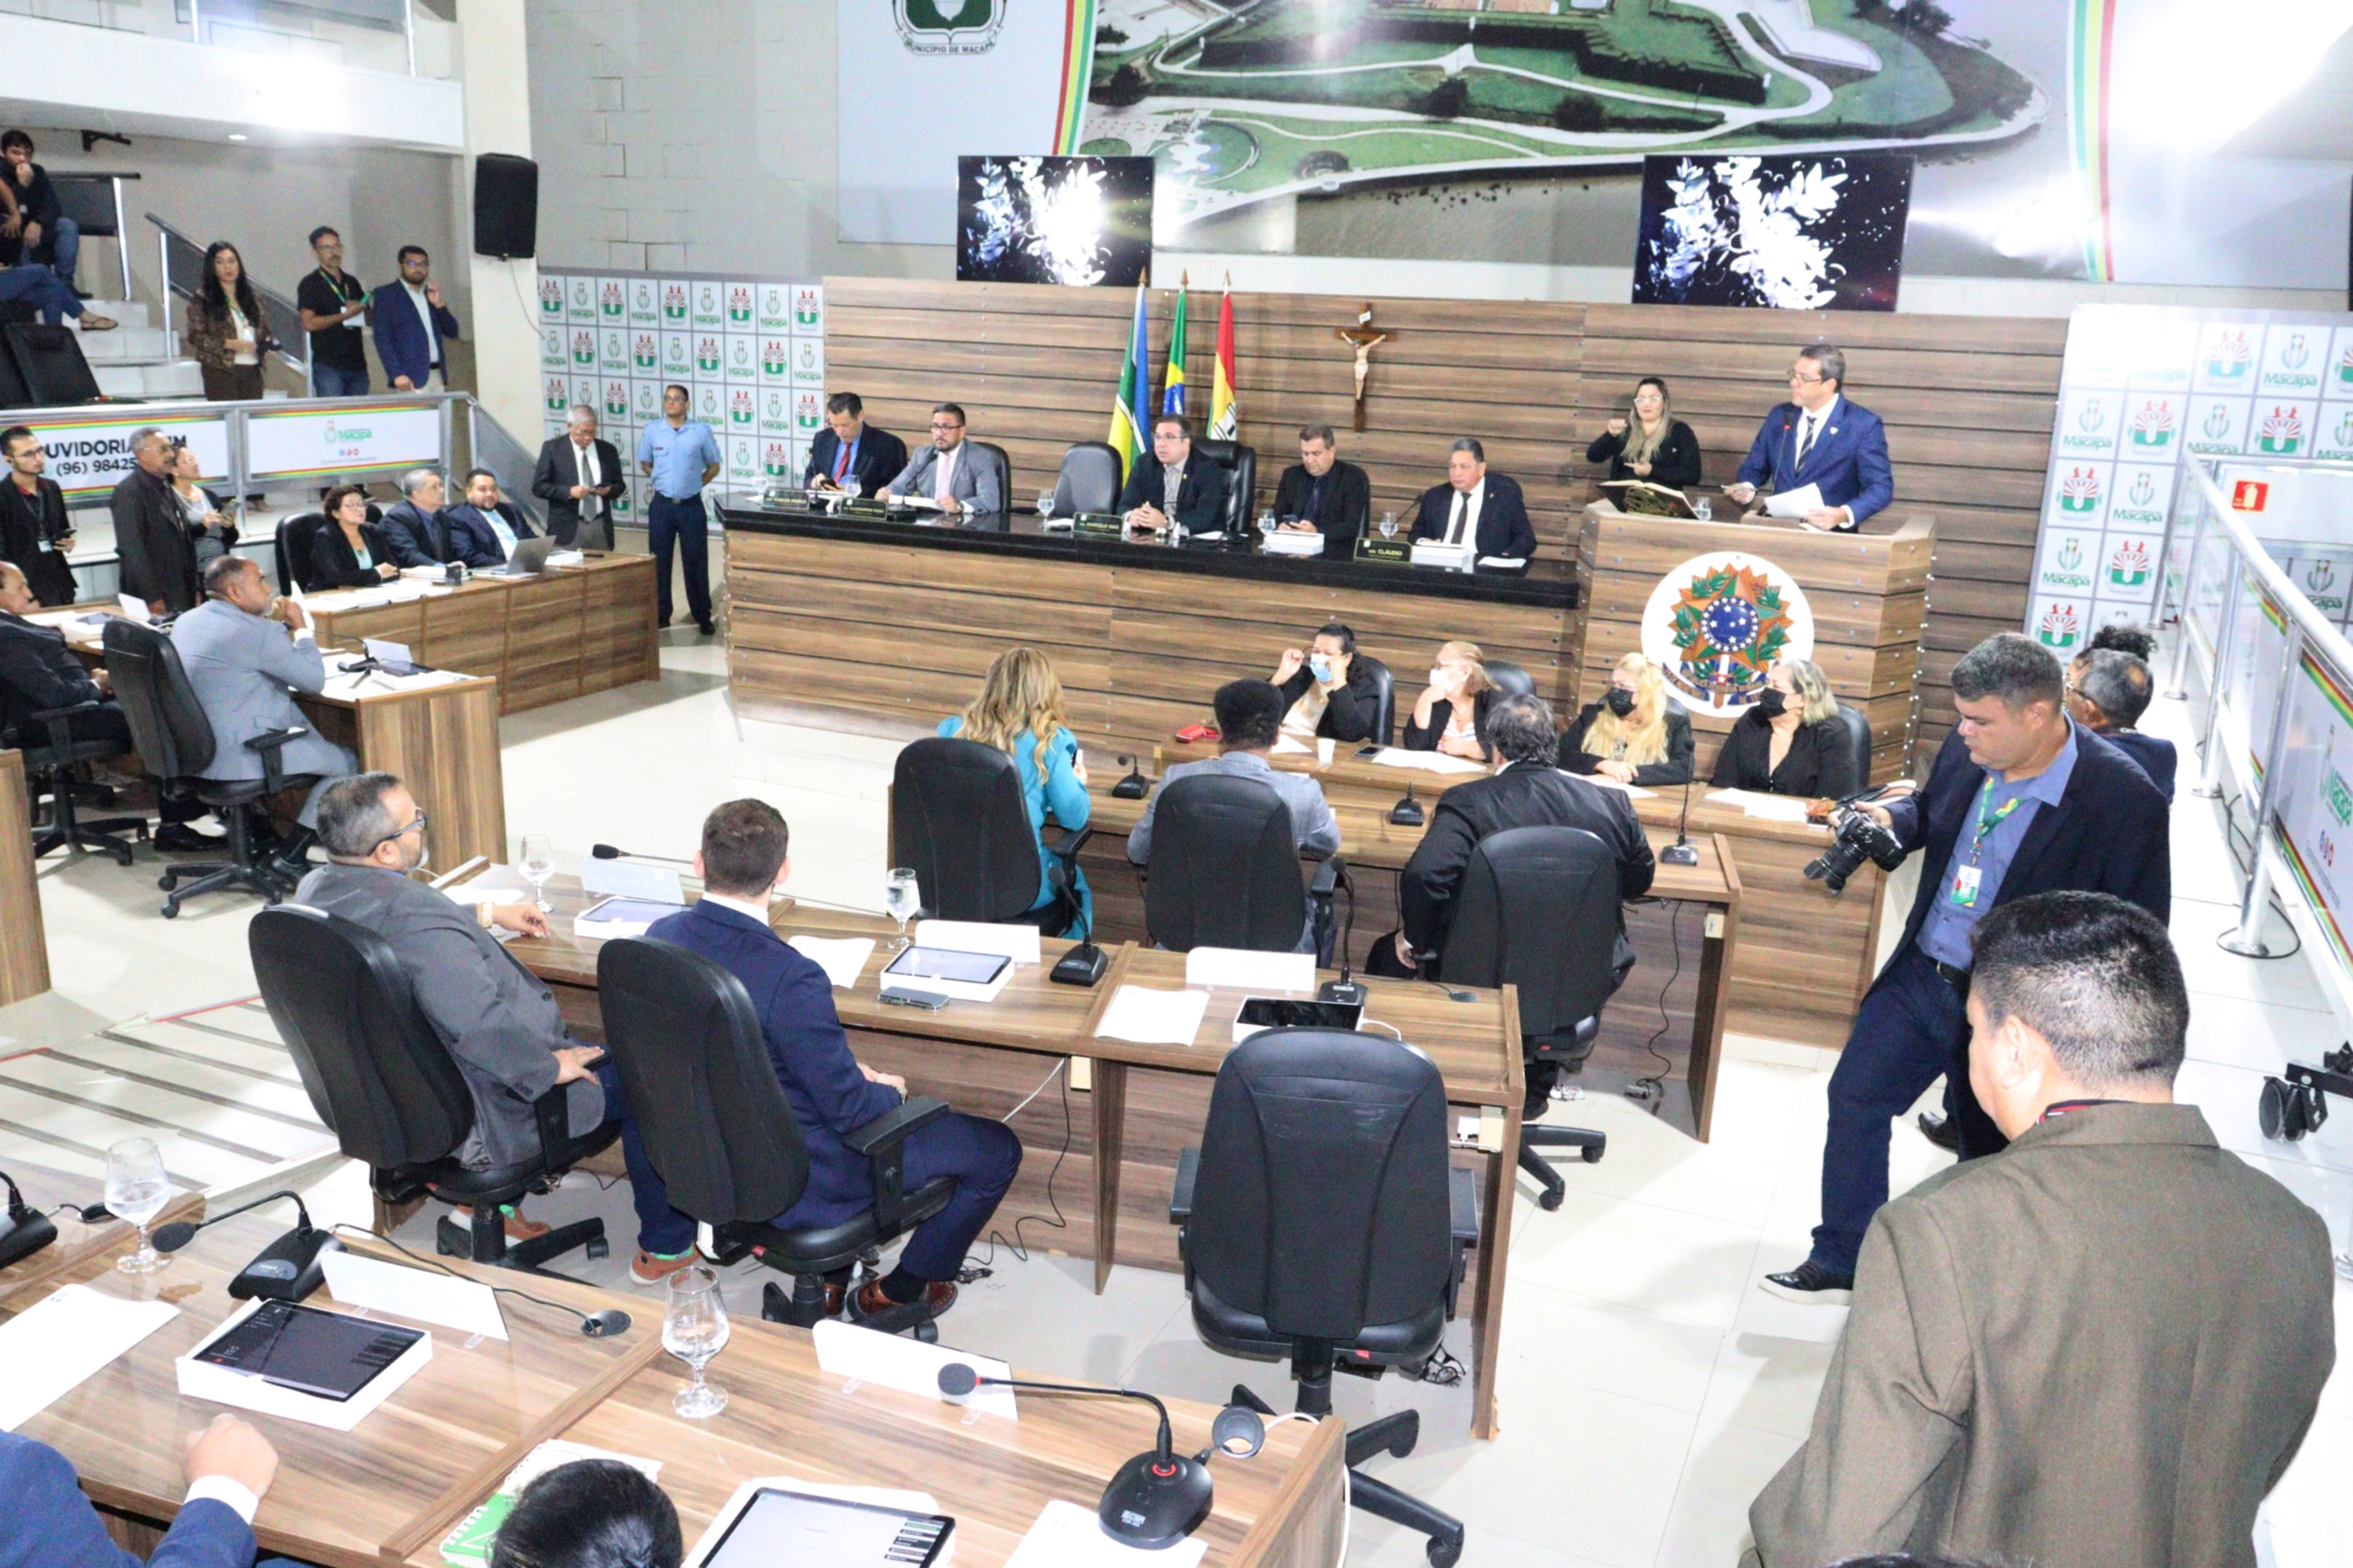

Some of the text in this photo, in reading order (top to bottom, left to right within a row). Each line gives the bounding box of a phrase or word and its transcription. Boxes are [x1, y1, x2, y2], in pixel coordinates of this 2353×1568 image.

[949, 45, 960, 53] DE
[45, 439, 131, 459] UVIDORI
[56, 460, 87, 477] (96)
